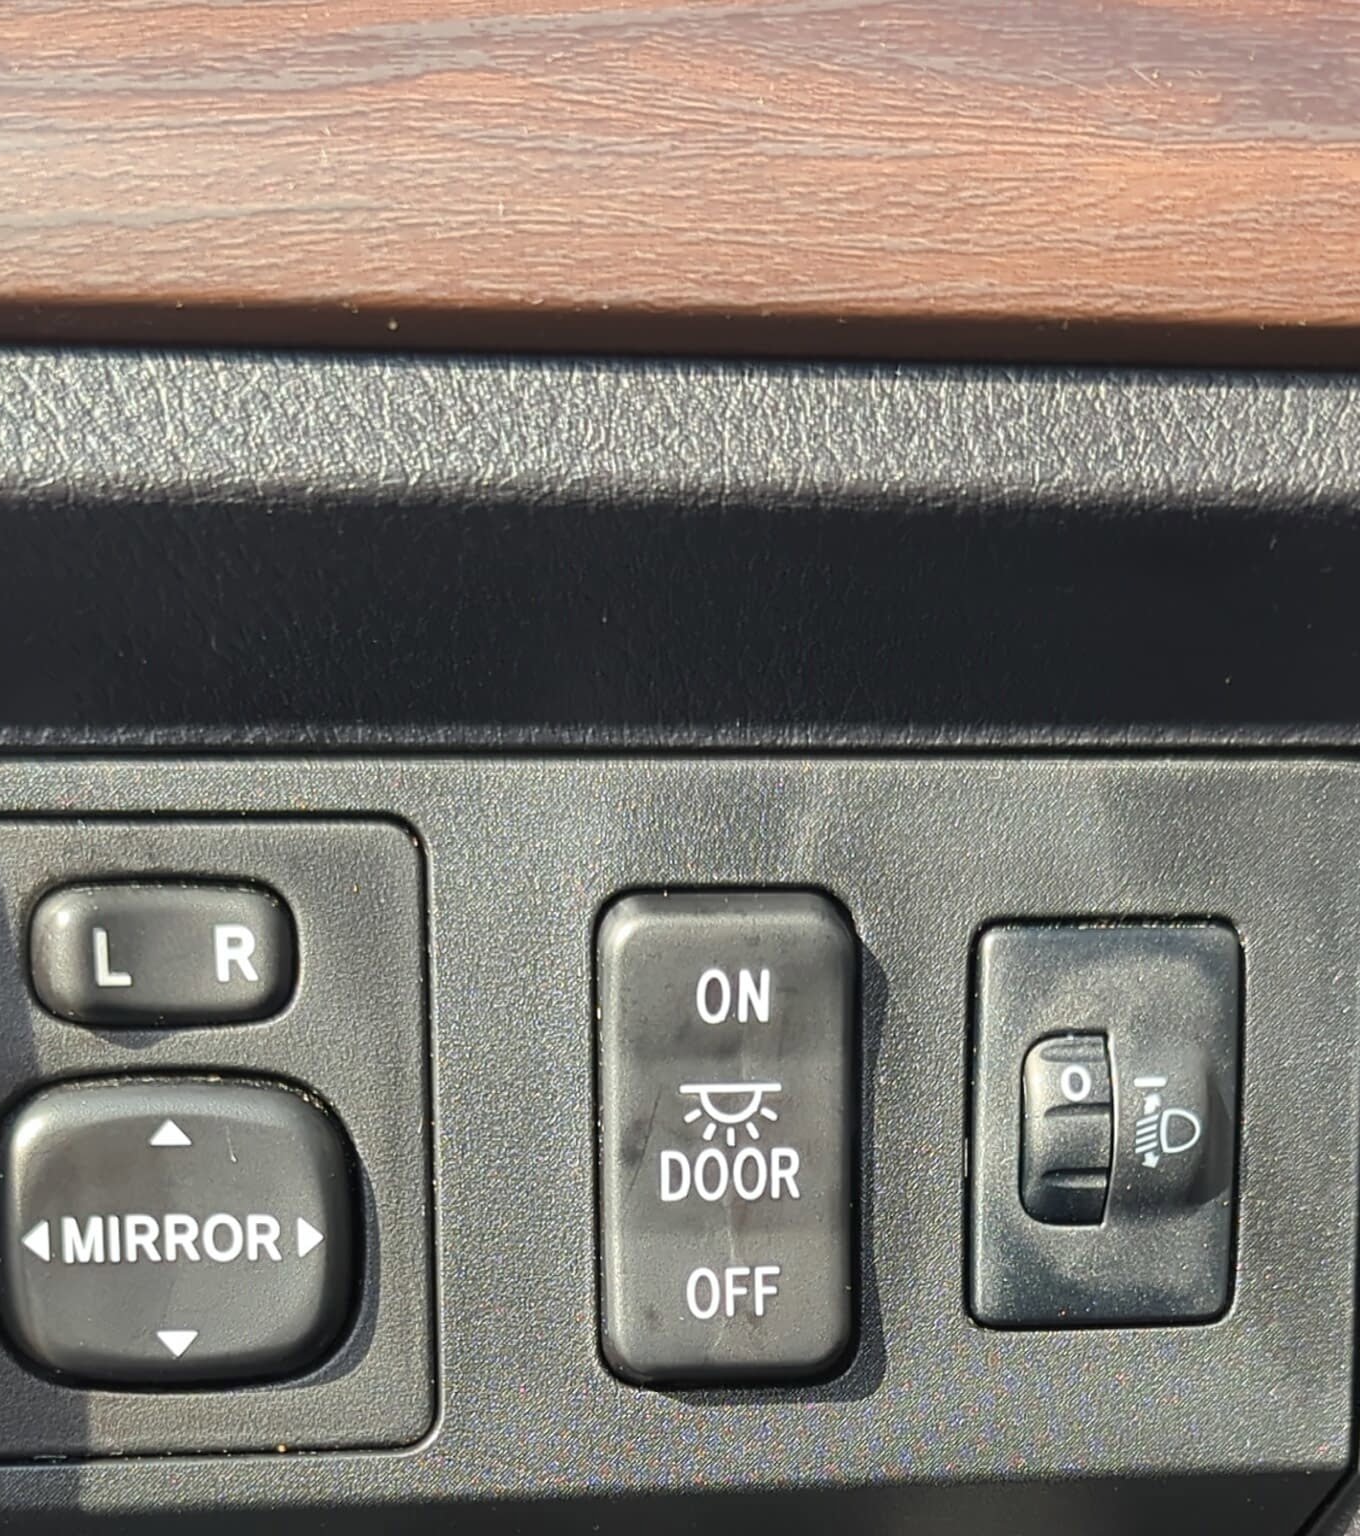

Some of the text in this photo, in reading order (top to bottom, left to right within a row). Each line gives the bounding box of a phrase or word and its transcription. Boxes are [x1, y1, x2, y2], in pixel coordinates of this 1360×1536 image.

[93, 923, 260, 987] L R
[695, 966, 772, 1025] ON
[659, 1146, 801, 1203] DOOR
[61, 1212, 283, 1265] MIRROR
[685, 1265, 781, 1321] OFF
